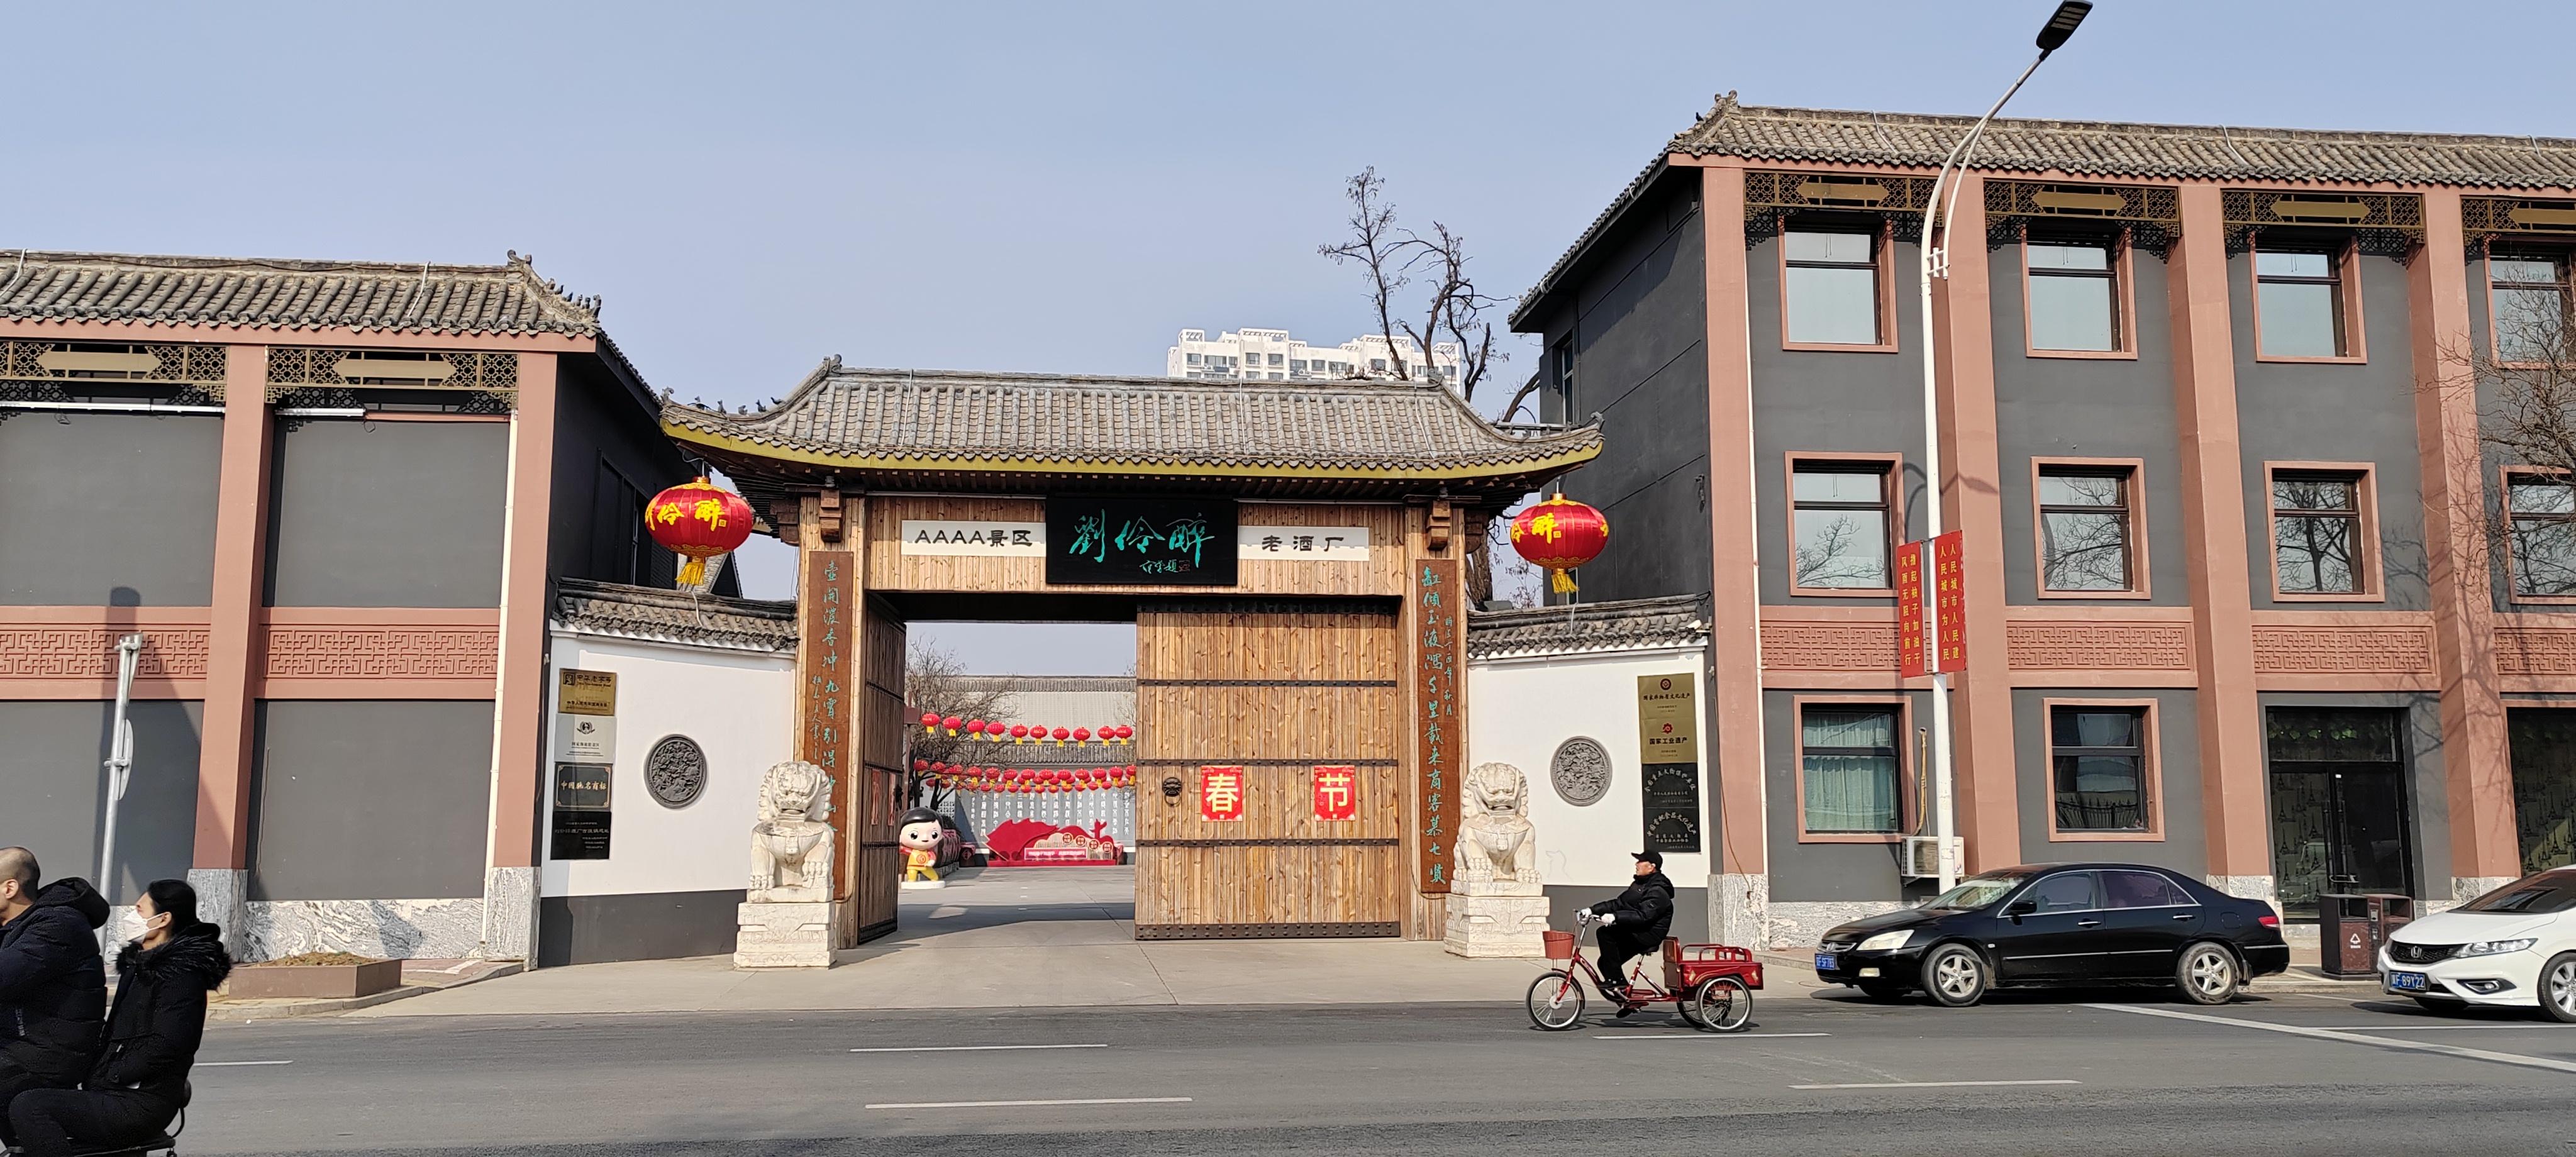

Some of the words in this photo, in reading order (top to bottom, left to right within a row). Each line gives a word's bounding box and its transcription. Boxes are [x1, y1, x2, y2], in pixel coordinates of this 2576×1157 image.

[914, 529, 1033, 548] AAAA景区
[1261, 534, 1344, 552] 老酒厂
[1901, 556, 1911, 666] 风雨无阻向前行
[1910, 553, 1921, 665] 撸起袖子加油干
[1940, 545, 1950, 661] 人民城市为人民
[1950, 543, 1960, 660] 人民城市人民建
[1649, 737, 1688, 745] 国家工业遗产
[1206, 773, 1238, 812] 春
[1318, 773, 1351, 812] 节
